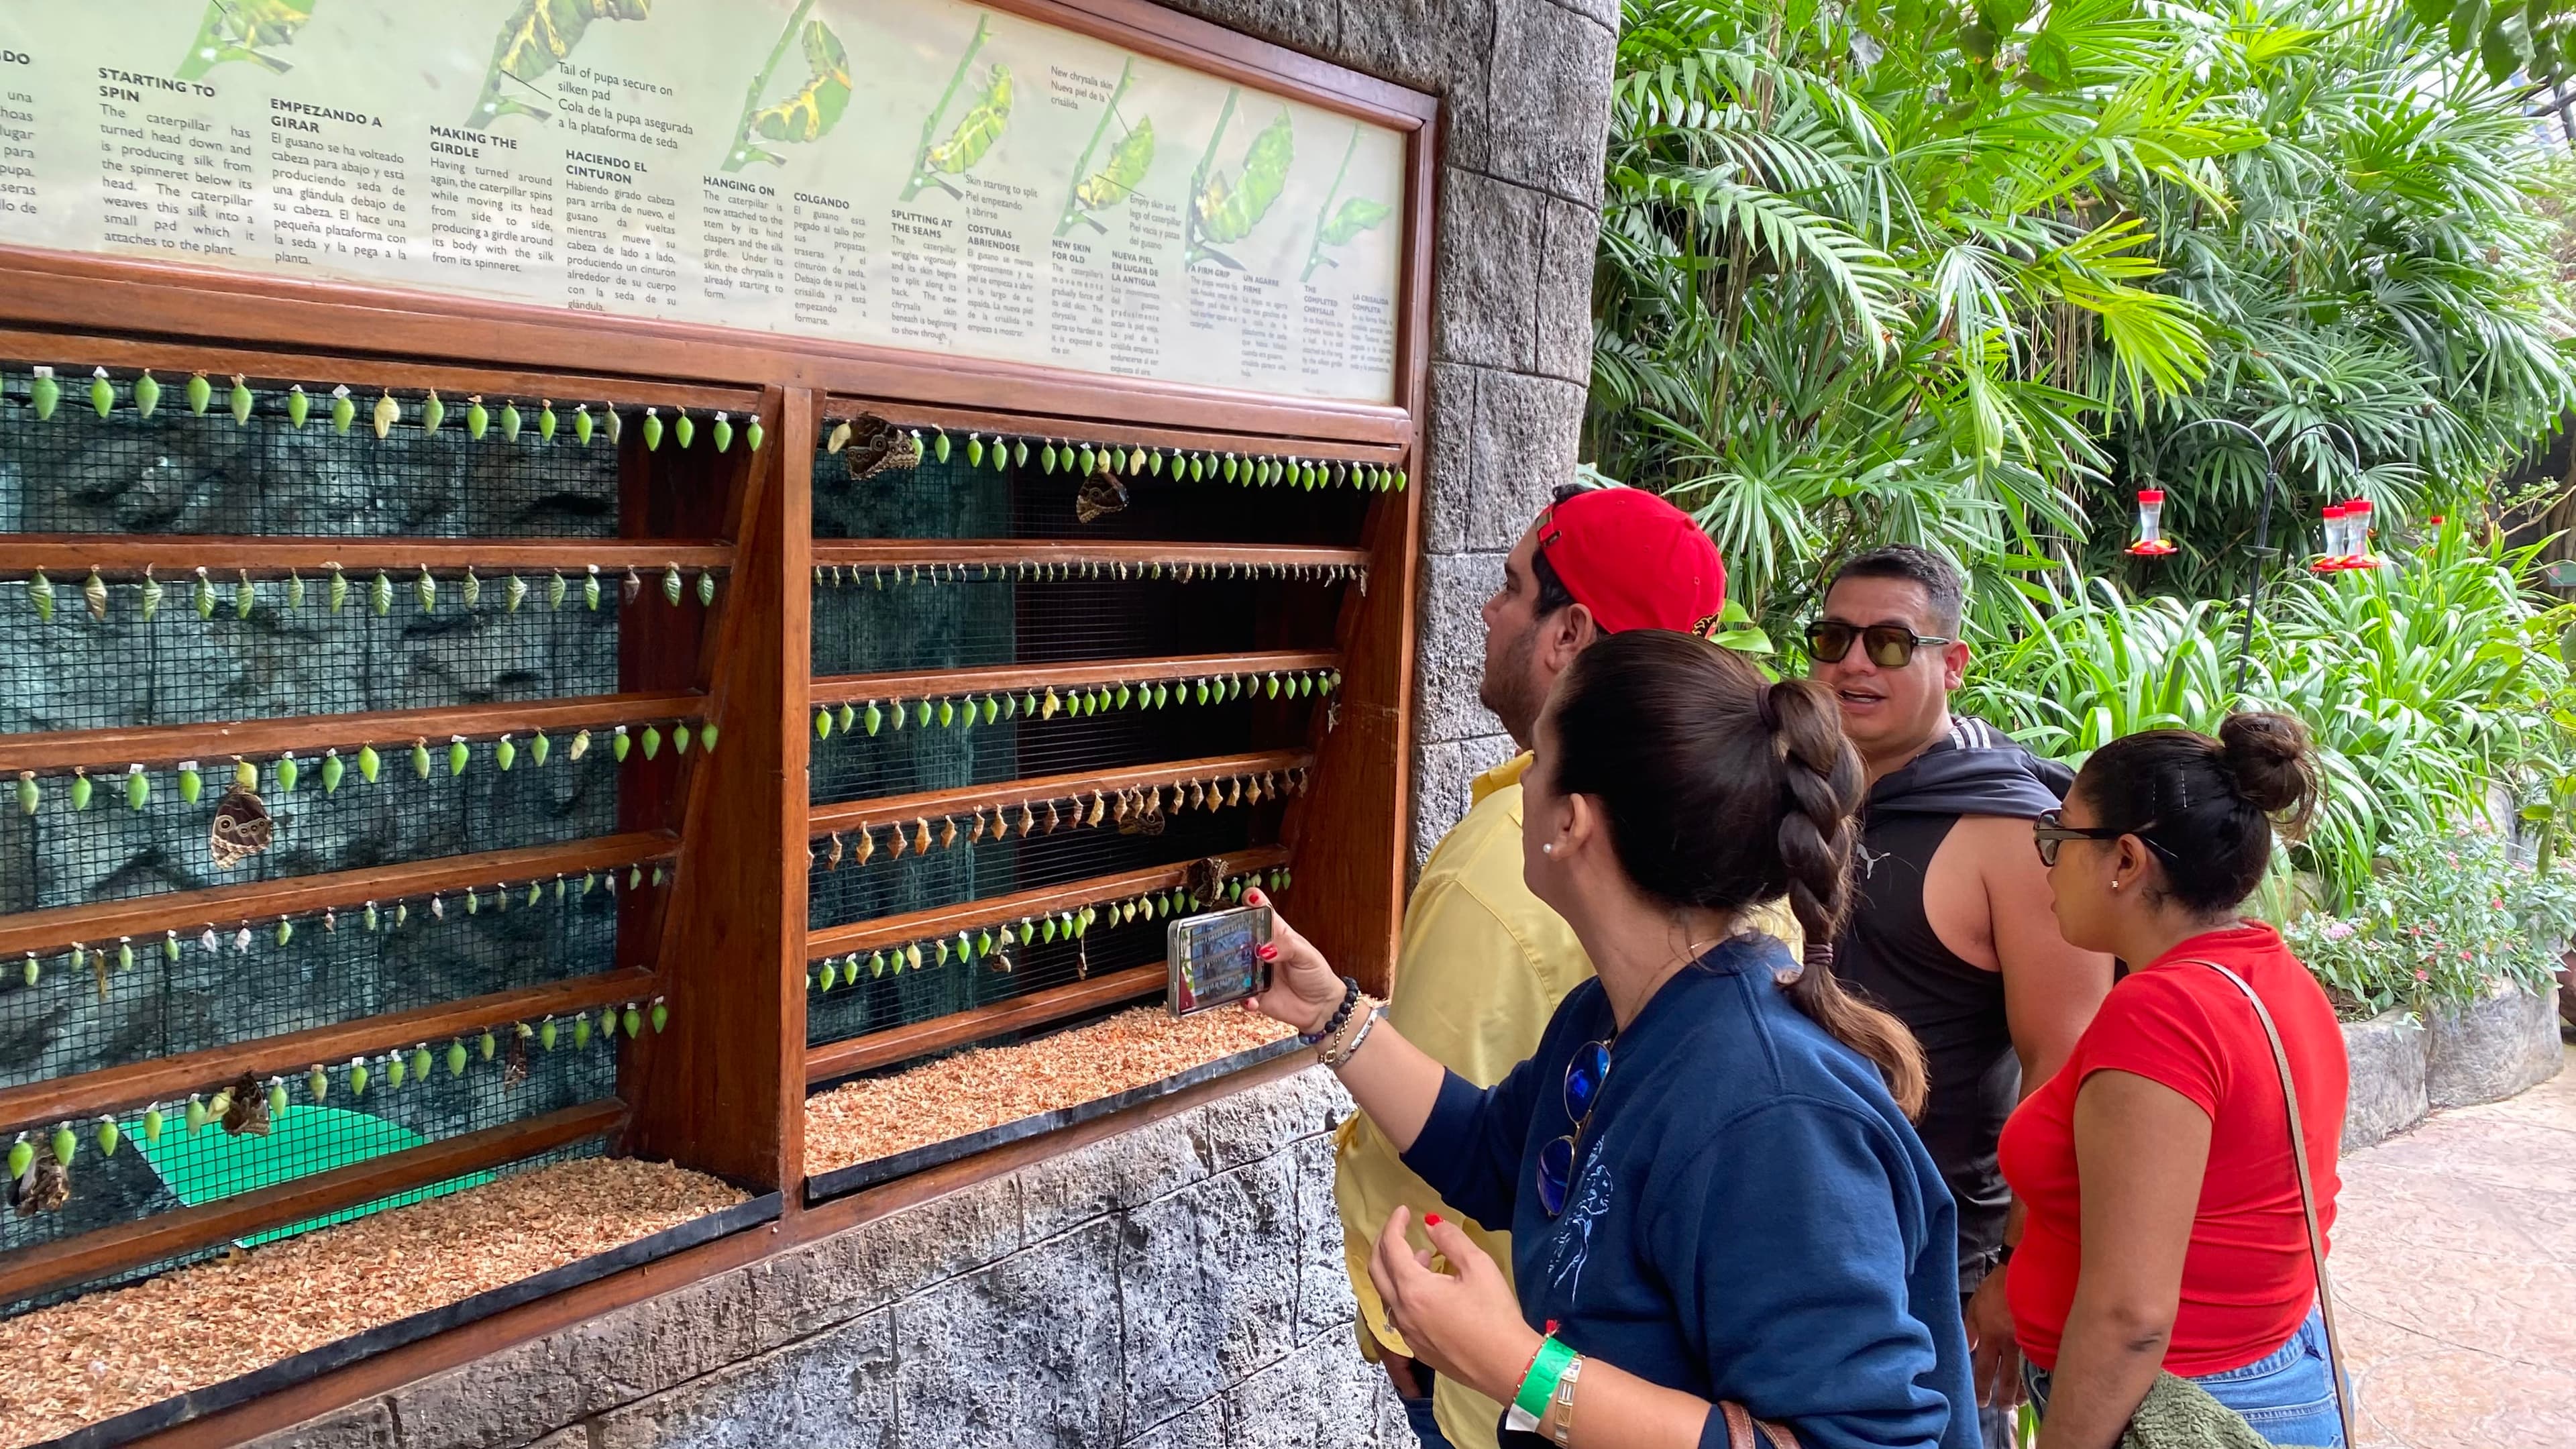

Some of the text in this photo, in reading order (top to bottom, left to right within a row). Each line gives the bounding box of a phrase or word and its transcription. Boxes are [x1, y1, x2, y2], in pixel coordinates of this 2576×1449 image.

[0, 50, 30, 64] DO
[99, 68, 215, 97] STARTING TO
[557, 61, 672, 96] Tail of pupa secure on
[1051, 65, 1113, 90] New chrysalis skin
[7, 91, 32, 103] una
[99, 86, 140, 102] SPIN
[558, 81, 610, 101] silken pad
[1051, 79, 1104, 102] Nueva piel de la
[99, 103, 250, 138] The caterpillar has
[270, 99, 382, 127] EMPEZANDO A
[558, 99, 693, 135] Cola de la pupa asegurada
[271, 116, 319, 133] GIRAR
[559, 118, 678, 150] a la plataforma de seda
[101, 125, 251, 155] turned head down and
[272, 132, 280, 143] El
[286, 138, 323, 150] gusano
[343, 144, 356, 156] ha
[359, 149, 404, 163] volteado
[430, 125, 517, 149] MAKING THE
[5, 146, 34, 158] para
[101, 140, 251, 172] is producing silk from
[430, 142, 479, 158] GIRDLE
[566, 149, 647, 172] HACIENDO EL
[102, 159, 252, 189] the spinneret below its
[272, 151, 309, 165] cabeza
[314, 159, 337, 169] para
[341, 162, 369, 176] abajo
[374, 168, 380, 178] y
[431, 157, 552, 186] Having turned around
[566, 166, 631, 184] CINTURON
[103, 176, 253, 206] head. The caterpillar
[431, 175, 552, 201] again, the caterpillar spins
[566, 180, 675, 206] Habiendo girado cabeza
[704, 176, 775, 196] HANGING ON
[966, 174, 1038, 198] Skin starting to split
[20, 202, 37, 213] de
[103, 197, 254, 224] weaves this silk into a
[431, 191, 553, 215] while moving its head
[704, 190, 783, 211] The caterpillar is
[794, 193, 849, 209] COLGANDO
[966, 191, 1022, 210] Piel empezando
[432, 205, 456, 217] from
[472, 213, 491, 222] side
[506, 218, 517, 226] to
[566, 212, 675, 234] gusano da vueltas
[892, 210, 953, 228] SPLITTING AT
[105, 214, 254, 241] small pad which it
[567, 226, 606, 239] mientras
[623, 235, 651, 245] mueve
[892, 223, 941, 238] THE SEAMS
[968, 224, 1012, 239] COSTURAS
[105, 232, 156, 246] attaches
[162, 239, 174, 248] to
[180, 239, 199, 251] the
[967, 236, 1020, 252] ABRIENDOSE
[1052, 239, 1091, 253] NEW SKIN
[1052, 252, 1085, 264] FOR OLD
[1112, 250, 1153, 264] NUEVA PIEL
[1112, 262, 1122, 270] EN
[1124, 264, 1147, 275] LUGAR
[1112, 274, 1156, 288] LA ANTIGUA
